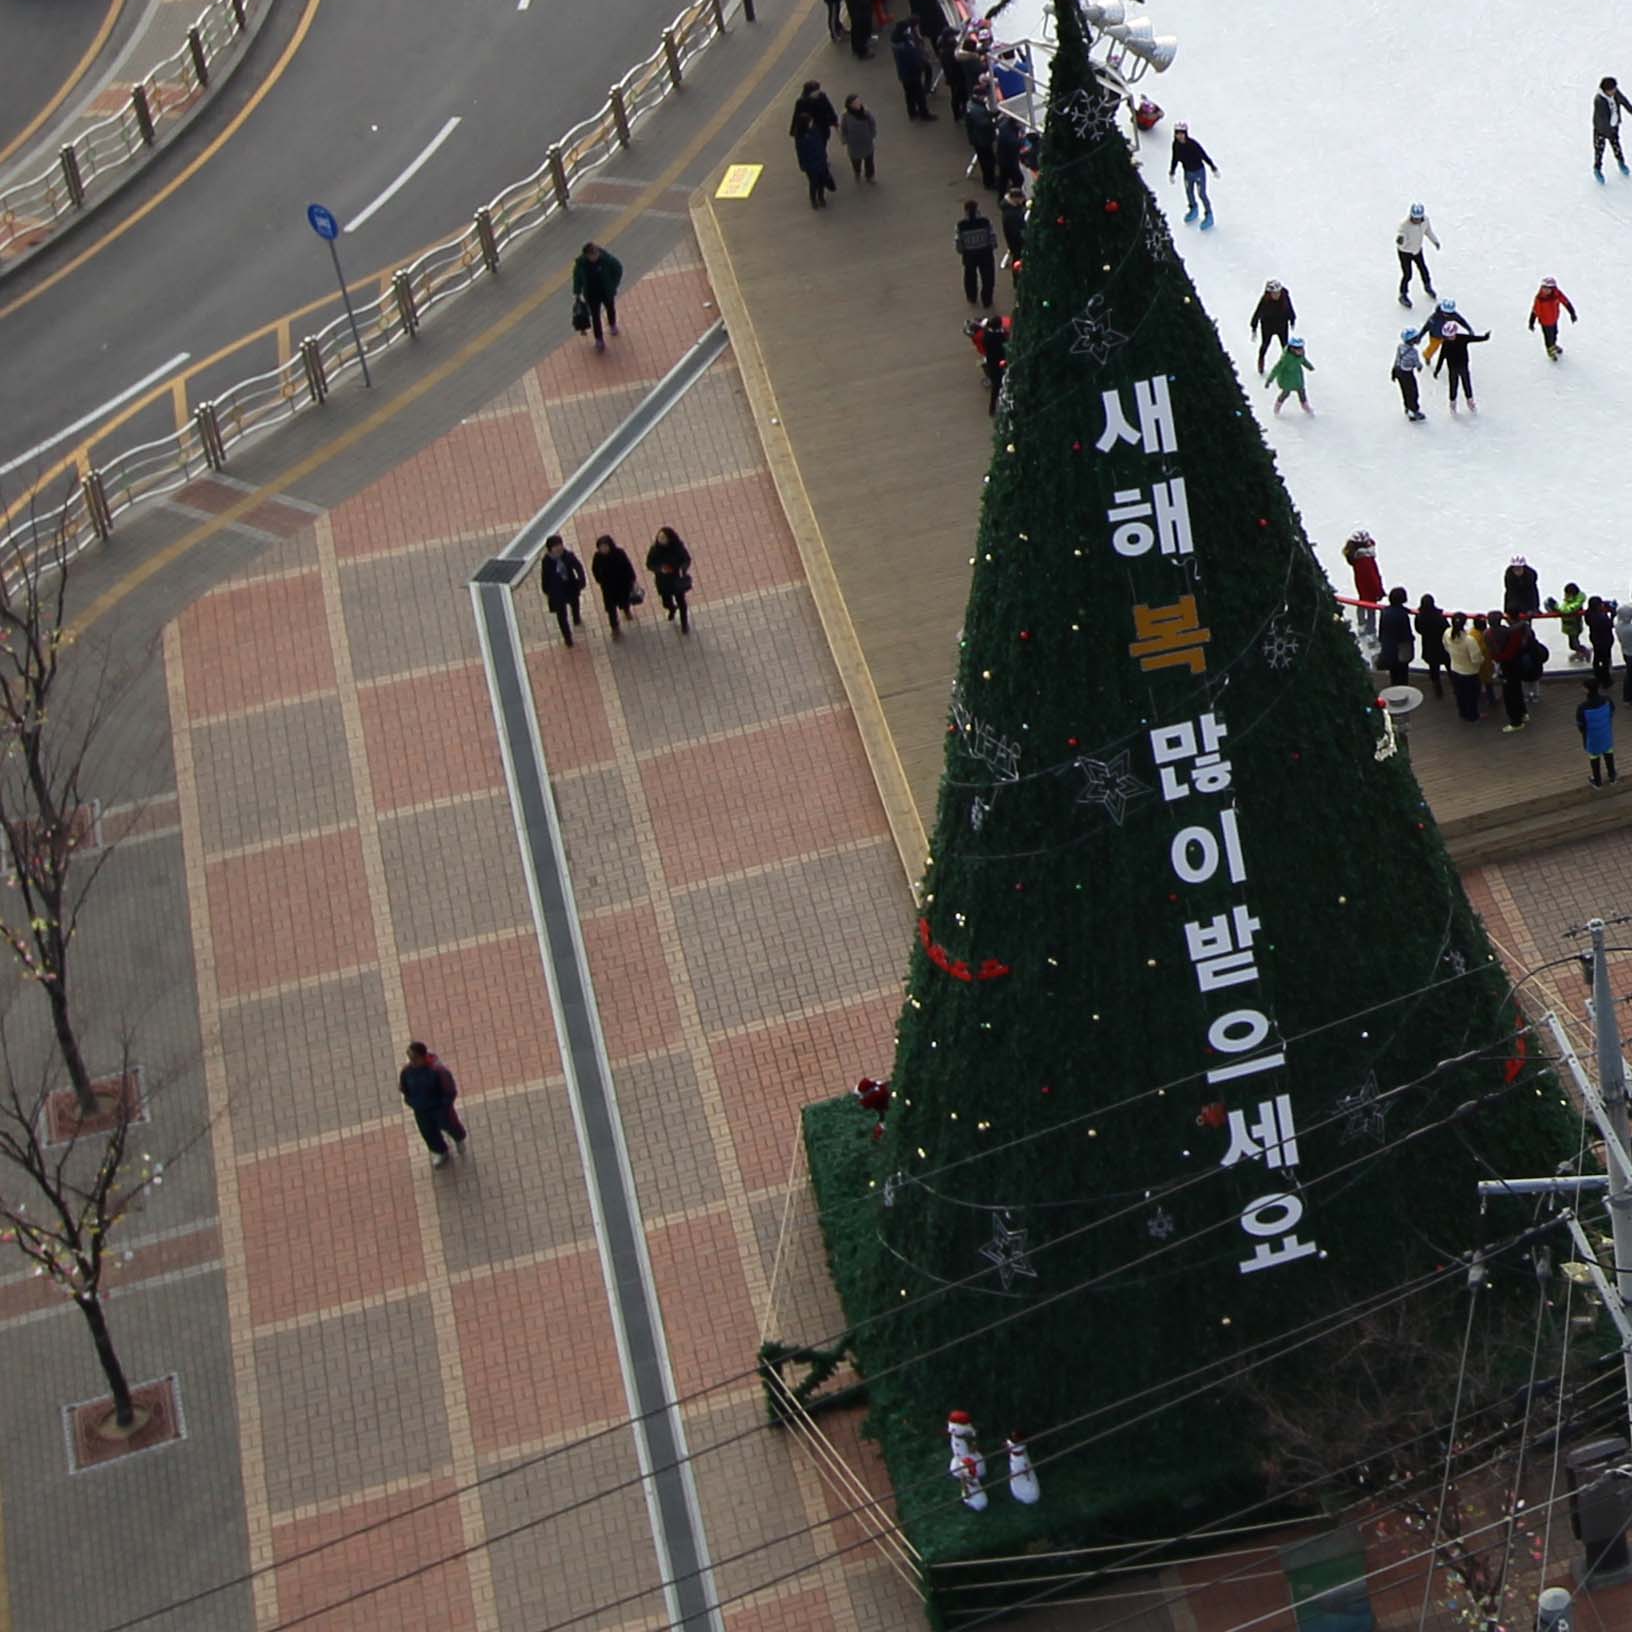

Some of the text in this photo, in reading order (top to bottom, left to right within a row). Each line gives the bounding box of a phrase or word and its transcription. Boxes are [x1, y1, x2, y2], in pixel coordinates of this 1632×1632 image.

[1096, 374, 1319, 1277] 새해 복 많이 받으세요
